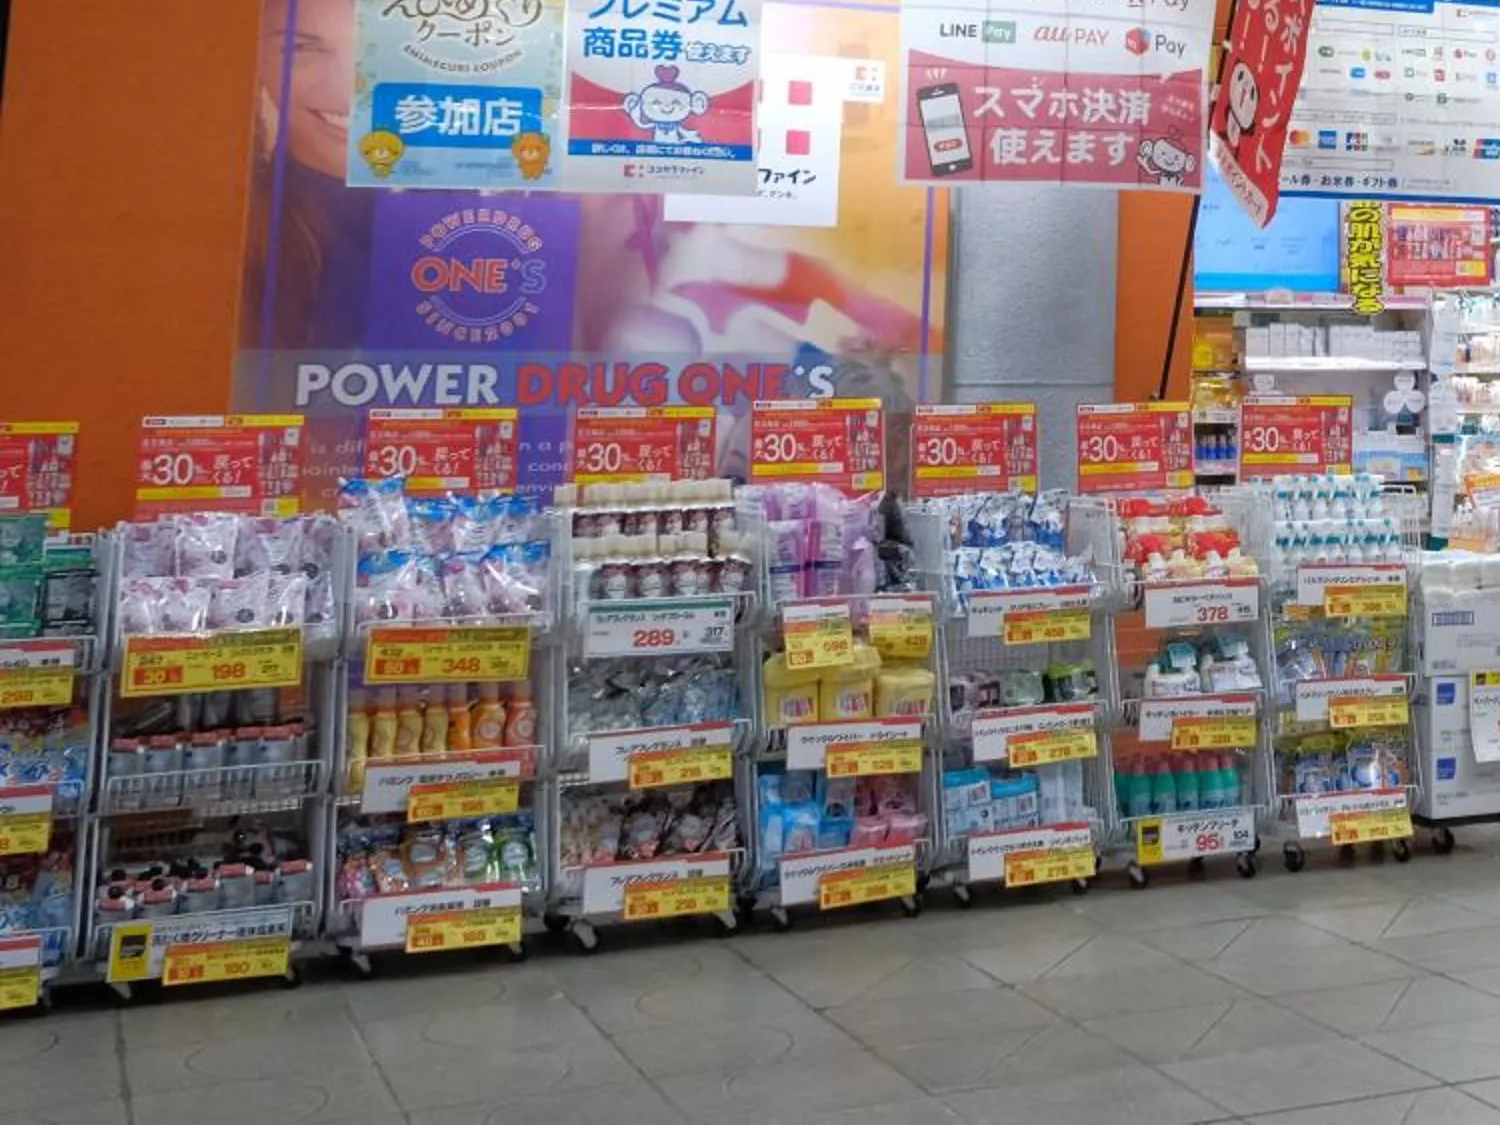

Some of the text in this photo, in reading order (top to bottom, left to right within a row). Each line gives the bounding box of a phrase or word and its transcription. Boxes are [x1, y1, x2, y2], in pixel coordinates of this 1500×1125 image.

[415, 20, 515, 48] クーポン
[583, 26, 683, 60] 商品券
[939, 23, 977, 39] LINE
[1074, 28, 1110, 47] PAY
[1154, 33, 1188, 58] Pay
[395, 95, 524, 137] 参加店
[972, 83, 1153, 127] スマホ決済
[989, 129, 1136, 166] 使えます
[410, 255, 548, 294] ONE'S
[295, 360, 836, 407] POWER DRUG ONE'S
[1197, 606, 1229, 622] 378
[633, 628, 675, 647] 289
[212, 662, 247, 680] 198
[442, 657, 481, 674] 348
